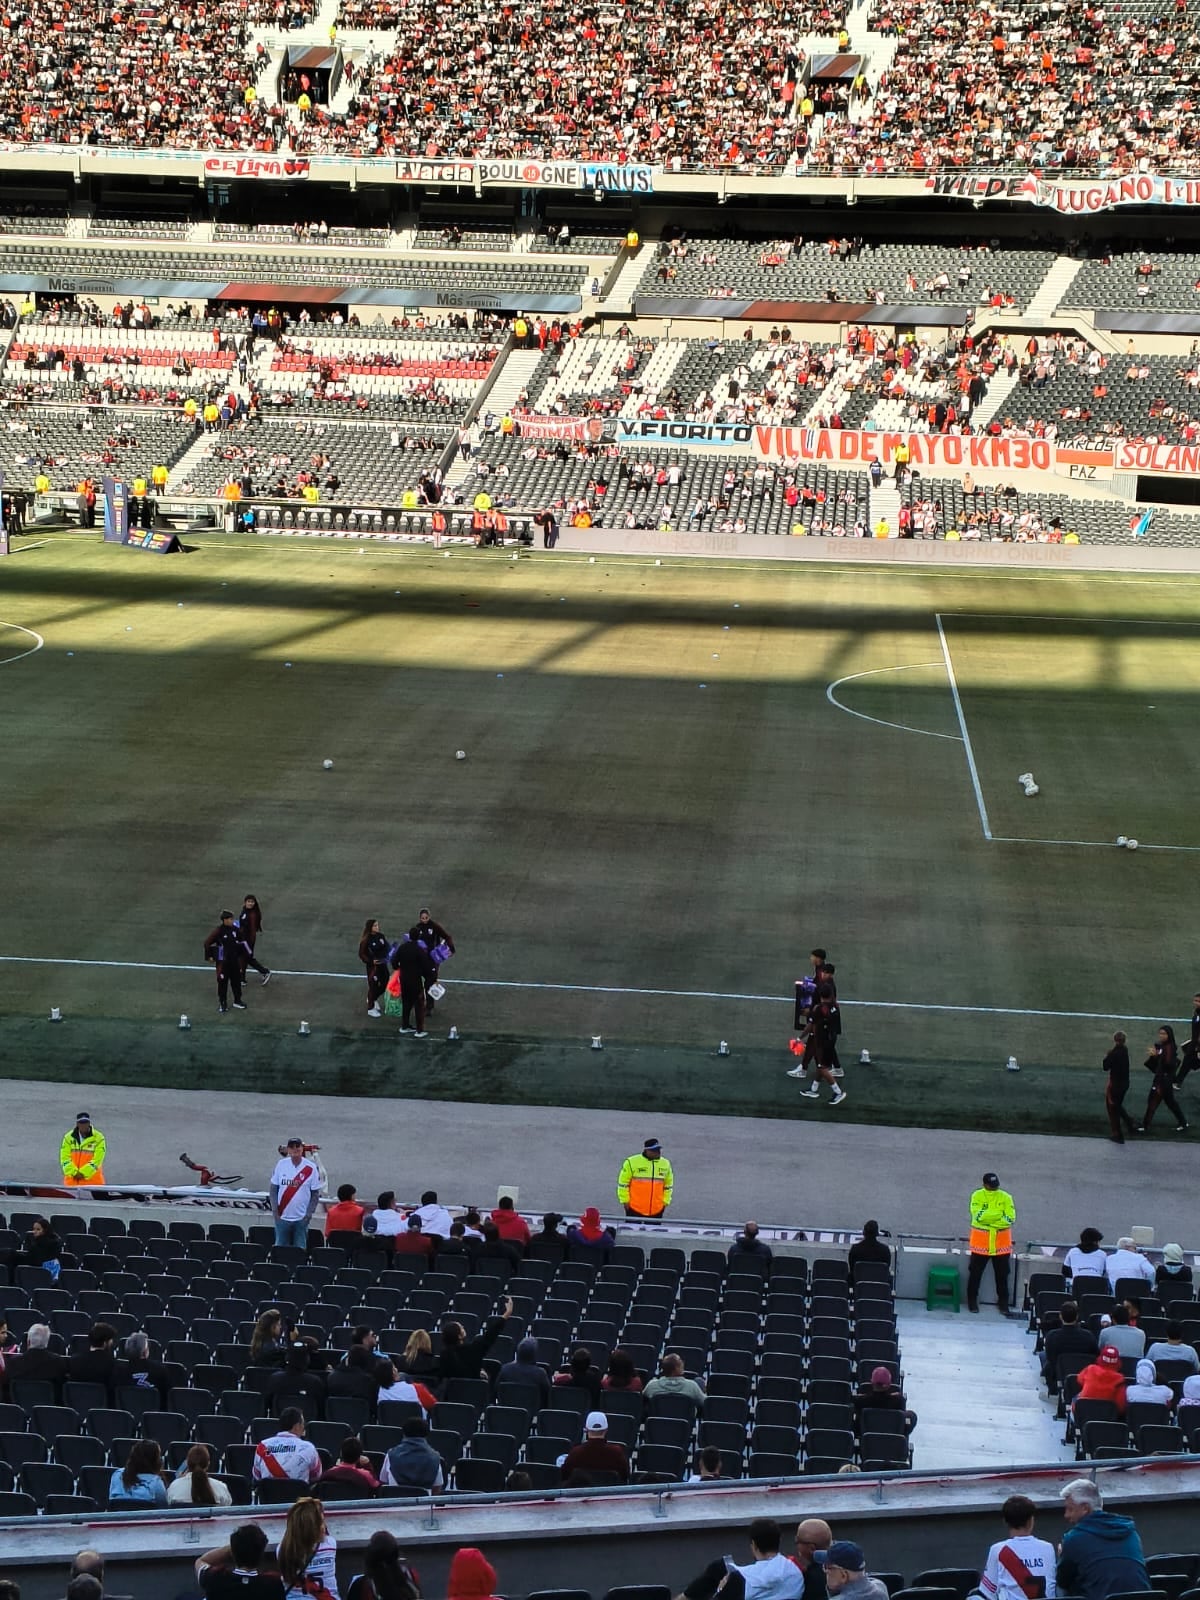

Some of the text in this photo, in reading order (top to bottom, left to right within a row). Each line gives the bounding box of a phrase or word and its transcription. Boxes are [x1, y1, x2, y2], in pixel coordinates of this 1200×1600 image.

[933, 175, 1027, 198] WILDE
[1056, 176, 1154, 212] LUGANO
[620, 420, 753, 443] V.FIORITO
[756, 425, 831, 460] VILLA
[839, 431, 879, 462] DE
[883, 433, 963, 465] MAYO
[1120, 443, 1200, 473] SOLAN
[1069, 465, 1097, 479] PAZ
[1007, 546, 1073, 562] ONLINE
[1021, 1557, 1044, 1568] ALAS
